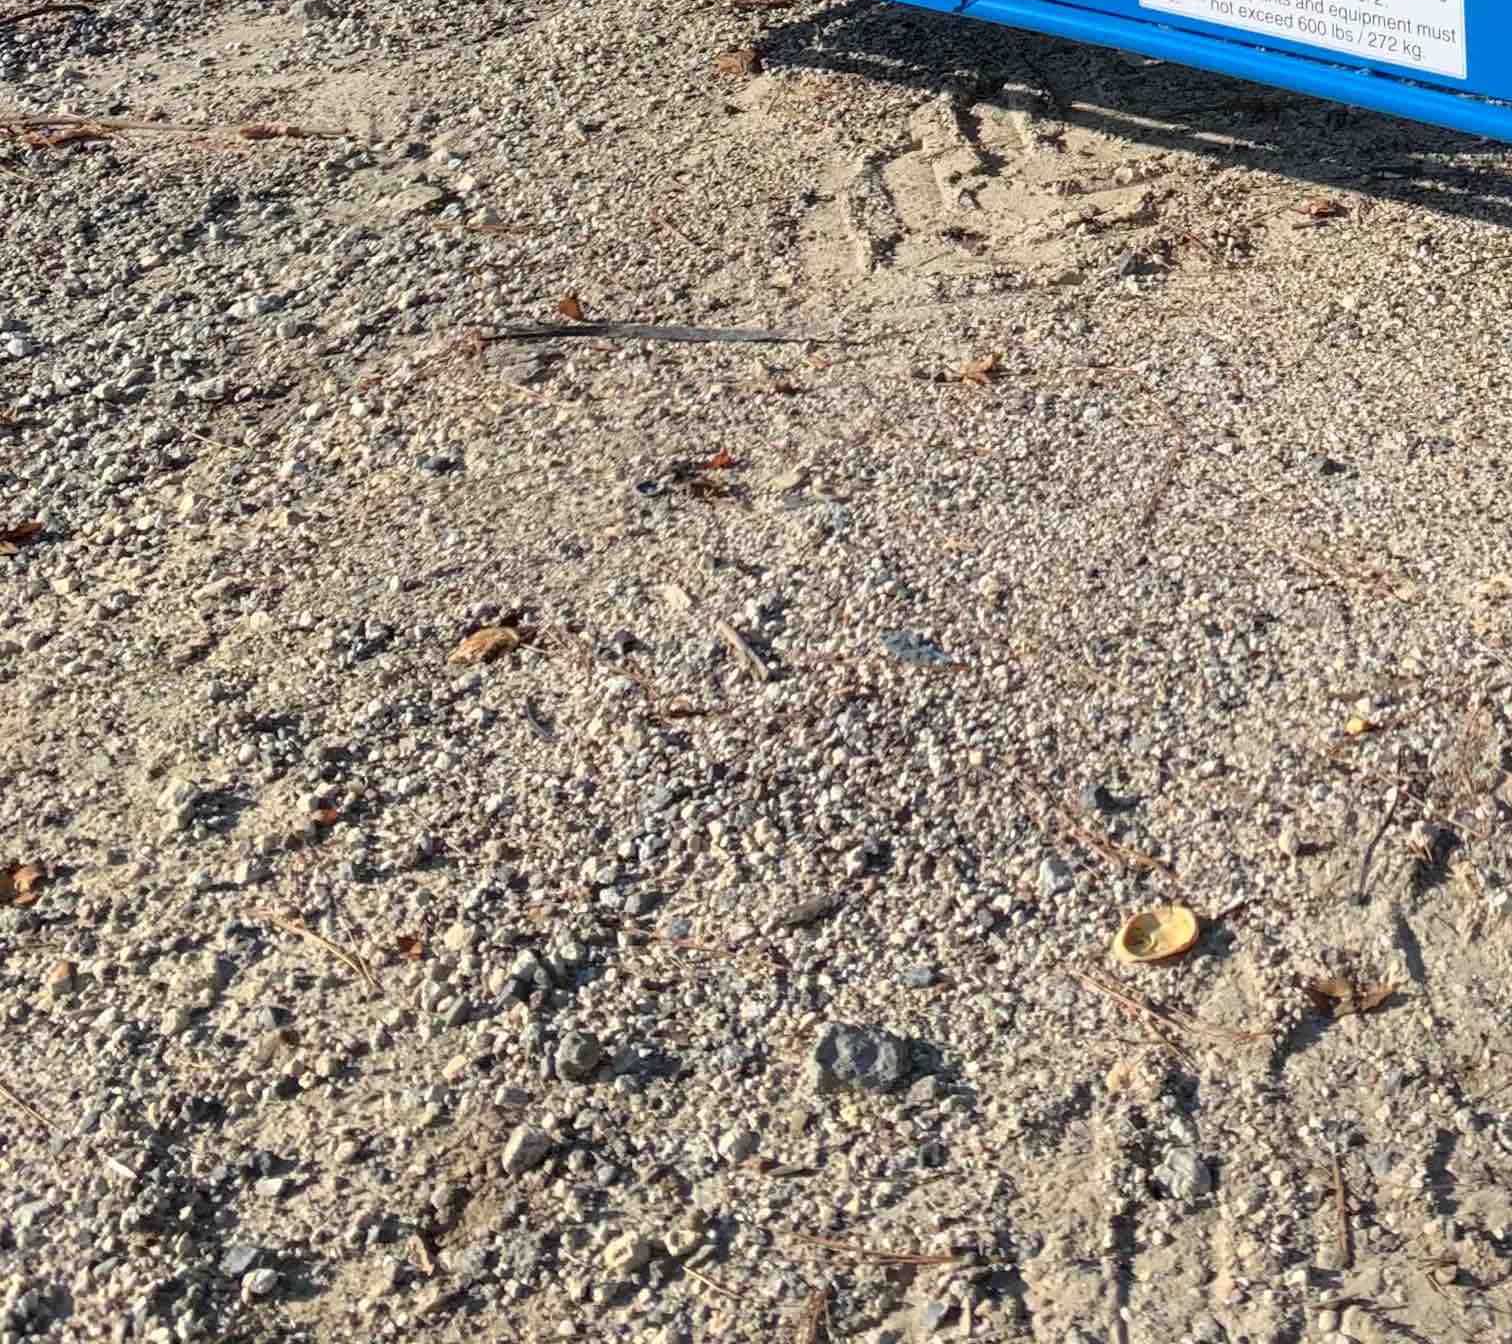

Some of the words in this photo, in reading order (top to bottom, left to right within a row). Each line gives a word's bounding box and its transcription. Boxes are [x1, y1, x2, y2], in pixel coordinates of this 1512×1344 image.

[1210, 0, 1233, 16] not
[1239, 6, 1293, 29] exceed
[1298, 16, 1327, 36] 600
[1331, 23, 1354, 43] lbs
[1358, 28, 1364, 44] /
[1368, 31, 1397, 52] 272
[1328, 4, 1411, 33] equipment
[1417, 23, 1456, 43] must
